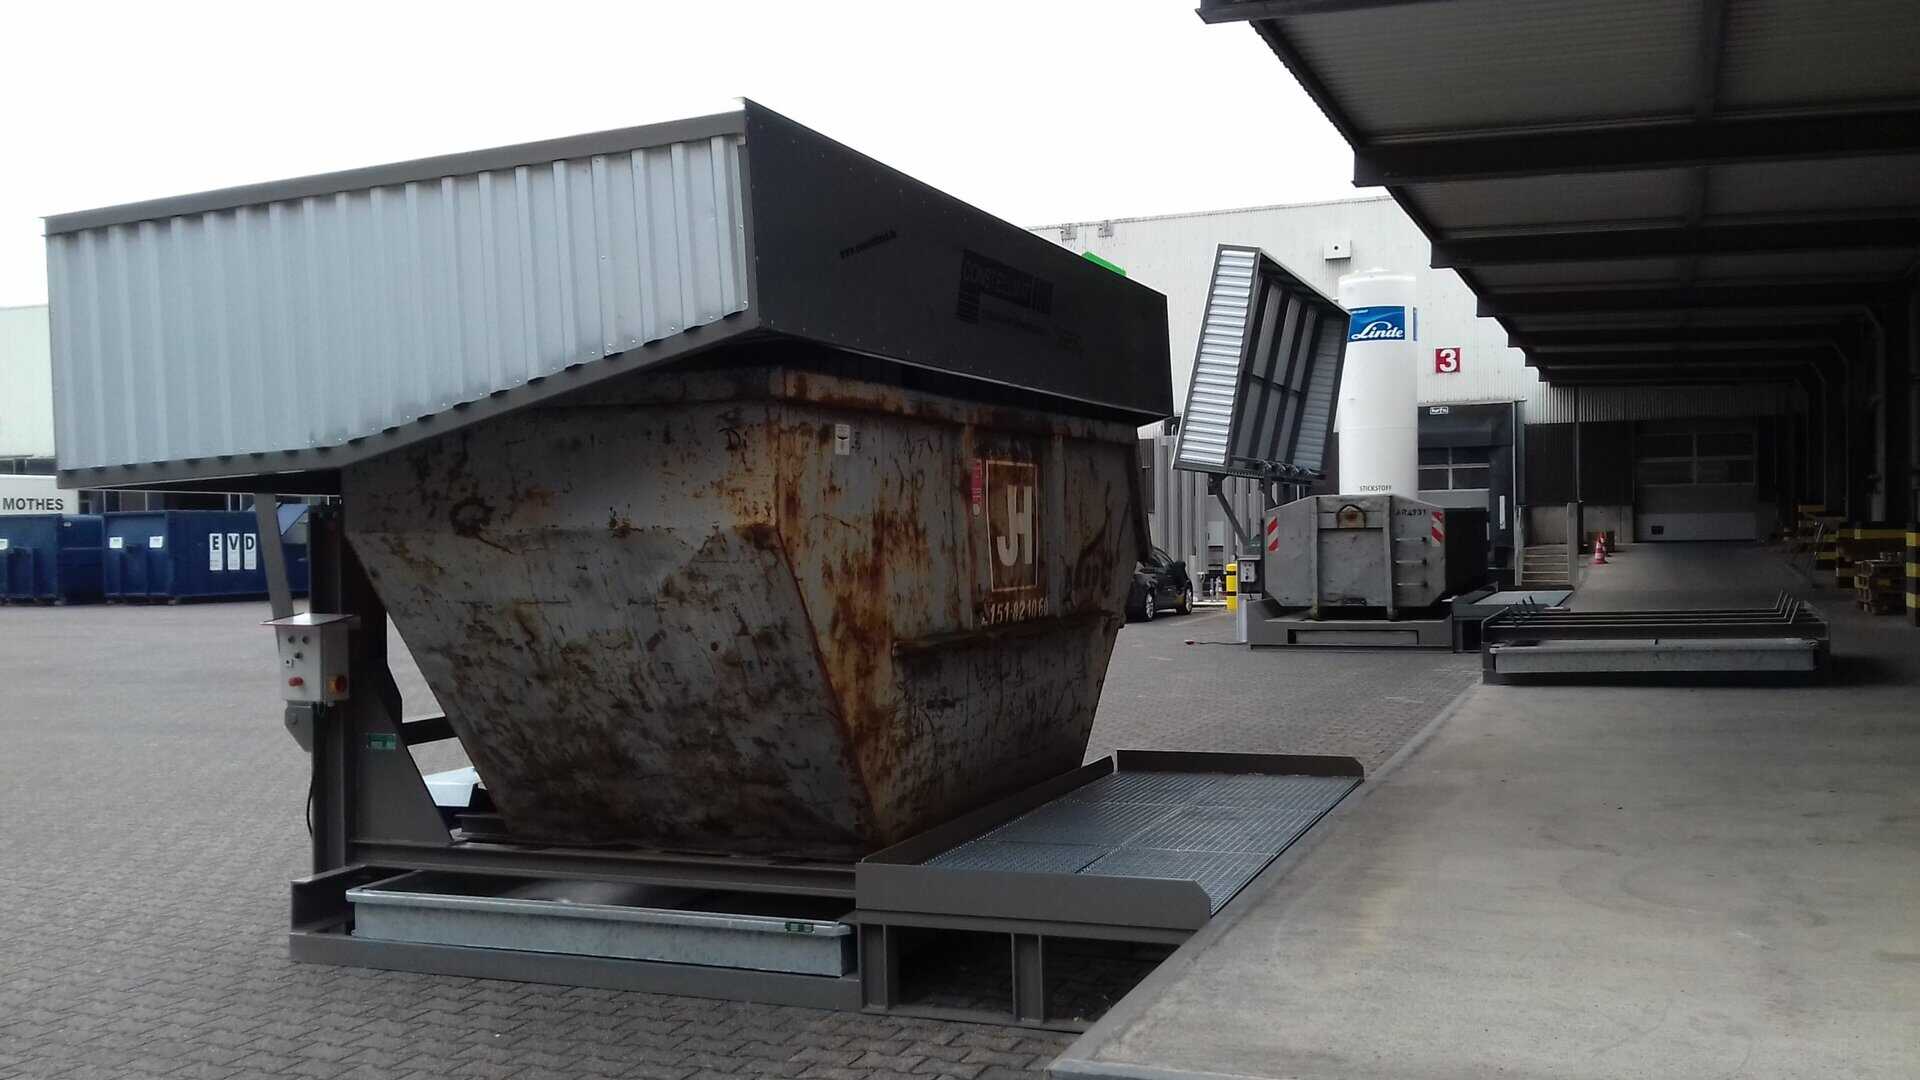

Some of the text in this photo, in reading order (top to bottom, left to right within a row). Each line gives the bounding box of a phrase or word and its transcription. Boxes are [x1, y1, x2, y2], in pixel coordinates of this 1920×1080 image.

[1351, 321, 1403, 339] Linde
[1440, 349, 1457, 373] 3
[1360, 485, 1391, 493] STICKSTOFF
[3, 498, 64, 510] MOTHES
[996, 485, 1032, 567] JH
